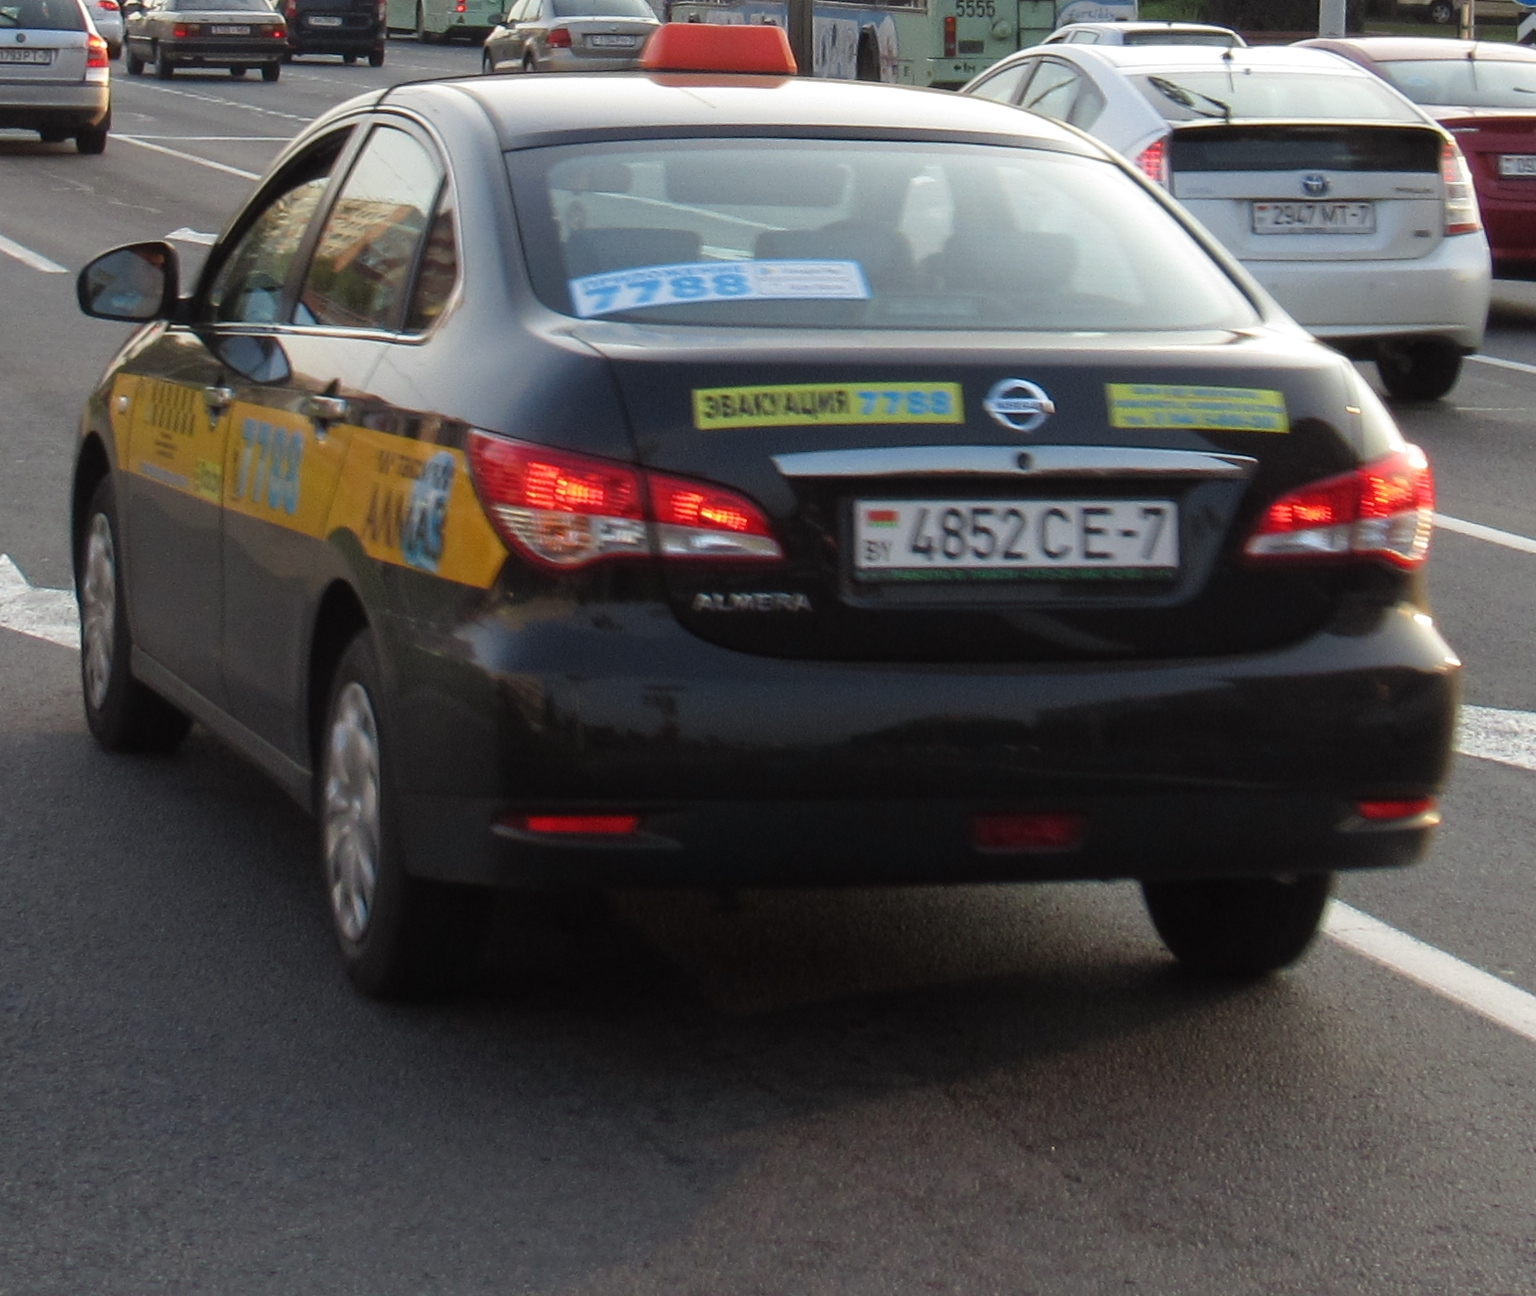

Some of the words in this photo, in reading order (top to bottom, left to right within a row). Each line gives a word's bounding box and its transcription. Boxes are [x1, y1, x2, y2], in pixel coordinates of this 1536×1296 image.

[581, 273, 753, 309] 7788
[703, 389, 851, 420] ЭВАКУАЦИЯ
[857, 390, 953, 416] 7788
[864, 539, 893, 561] BY
[692, 592, 811, 611] ALMERA
